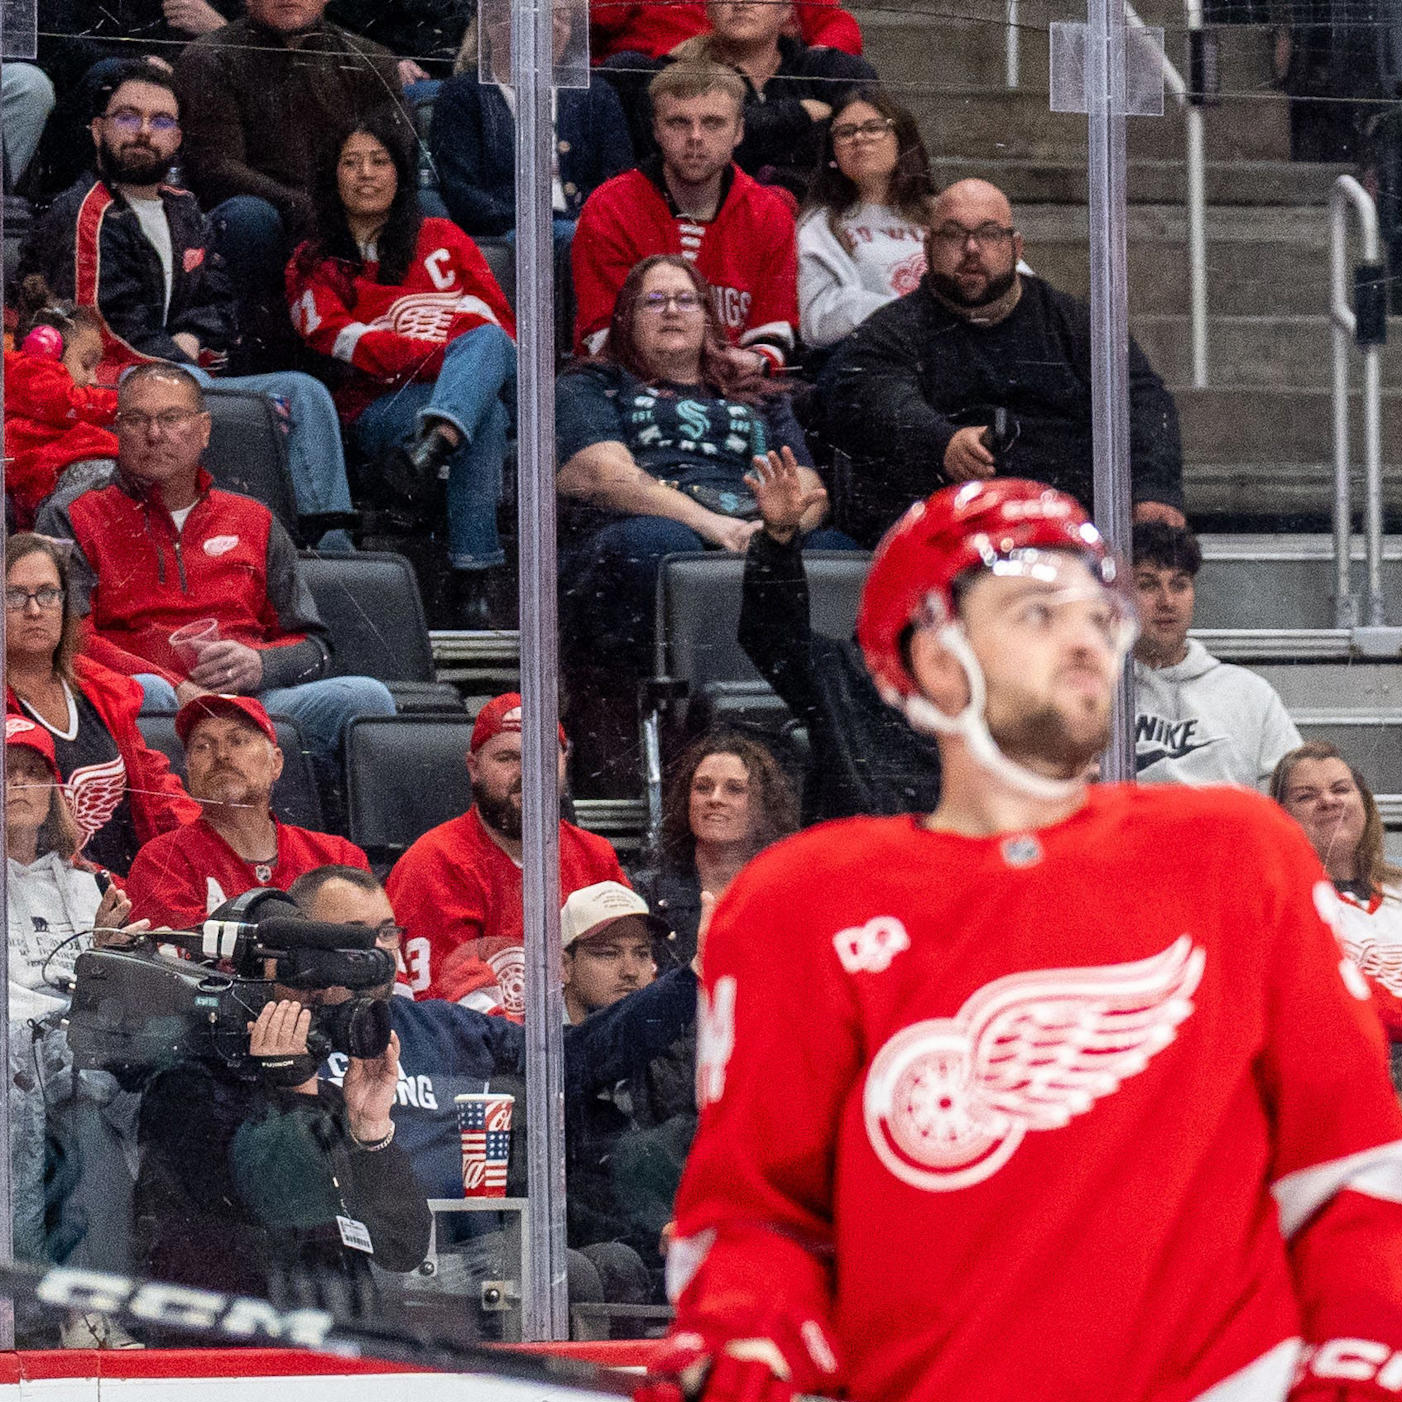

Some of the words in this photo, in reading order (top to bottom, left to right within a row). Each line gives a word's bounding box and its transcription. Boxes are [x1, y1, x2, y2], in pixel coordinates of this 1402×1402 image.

[424, 248, 456, 290] C
[1135, 713, 1199, 750] NIKE
[36, 1266, 333, 1346] CCM
